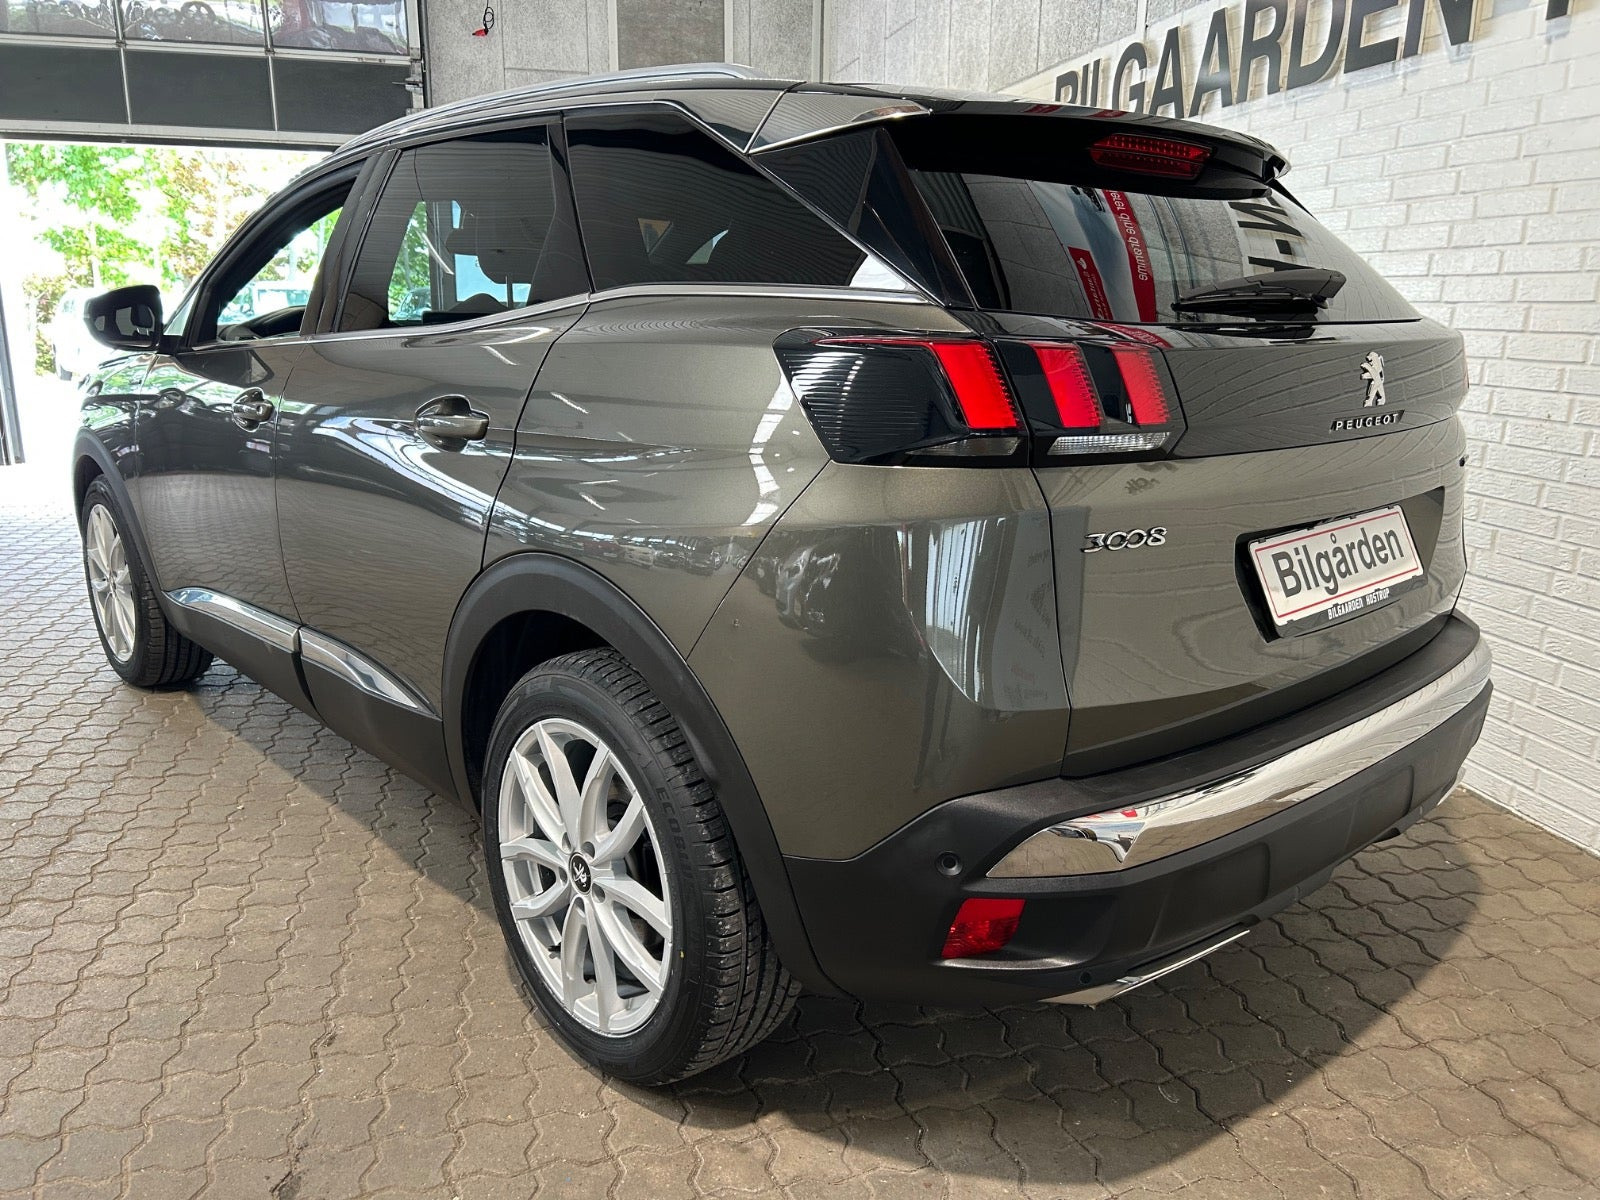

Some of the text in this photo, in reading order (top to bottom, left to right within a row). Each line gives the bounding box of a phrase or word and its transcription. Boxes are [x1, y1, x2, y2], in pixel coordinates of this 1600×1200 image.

[1332, 412, 1401, 431] PEUGEOT
[1082, 526, 1168, 553] 3008
[1271, 527, 1404, 596] Bilgården
[1327, 597, 1364, 620] BILGAARDEN
